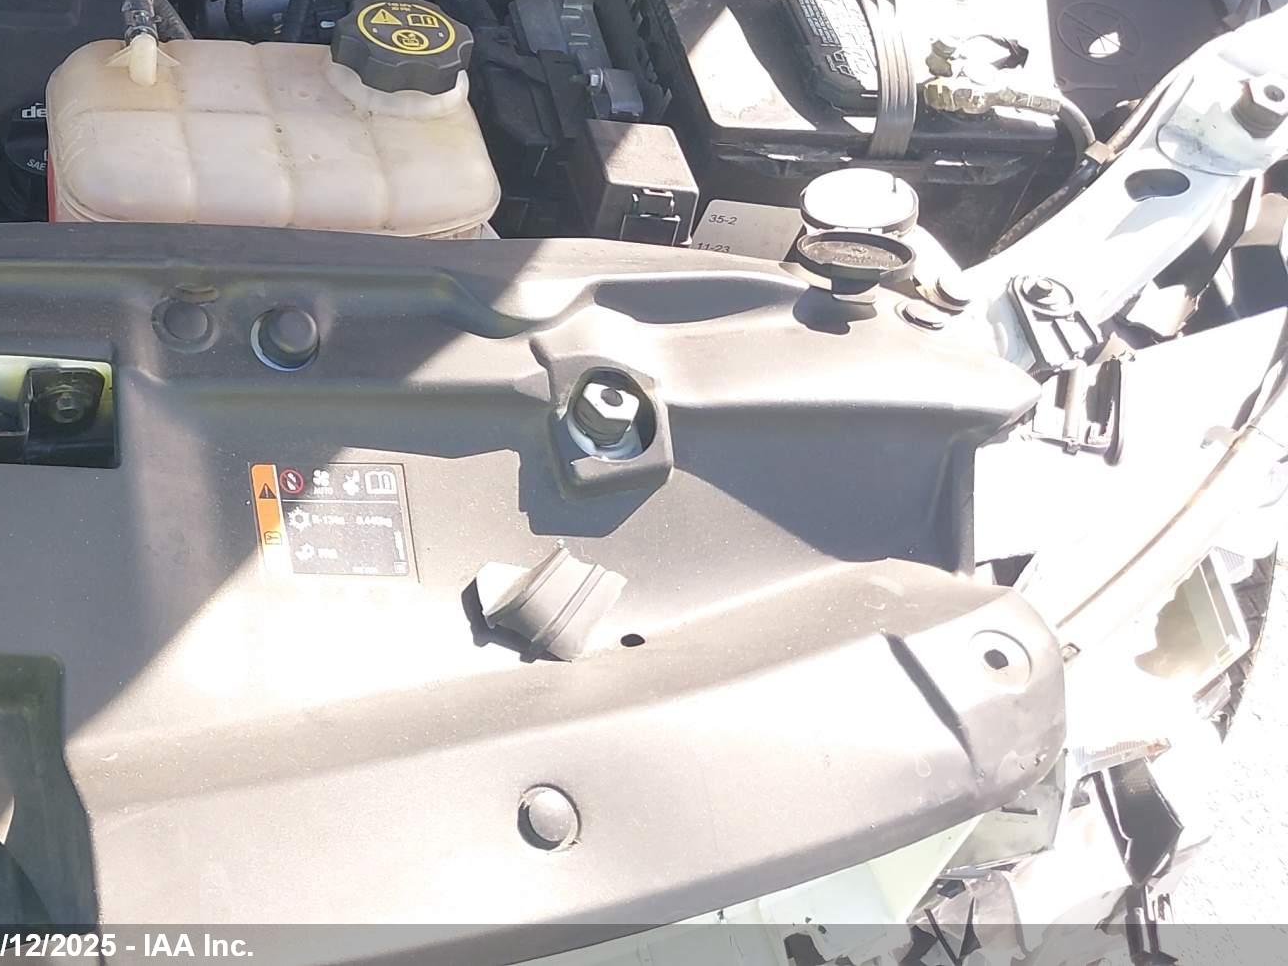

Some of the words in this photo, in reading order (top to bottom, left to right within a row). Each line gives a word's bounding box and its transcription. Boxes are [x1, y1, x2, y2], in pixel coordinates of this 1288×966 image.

[26, 158, 48, 171] SAE
[708, 214, 738, 226] 35-2
[696, 242, 731, 254] 11-23
